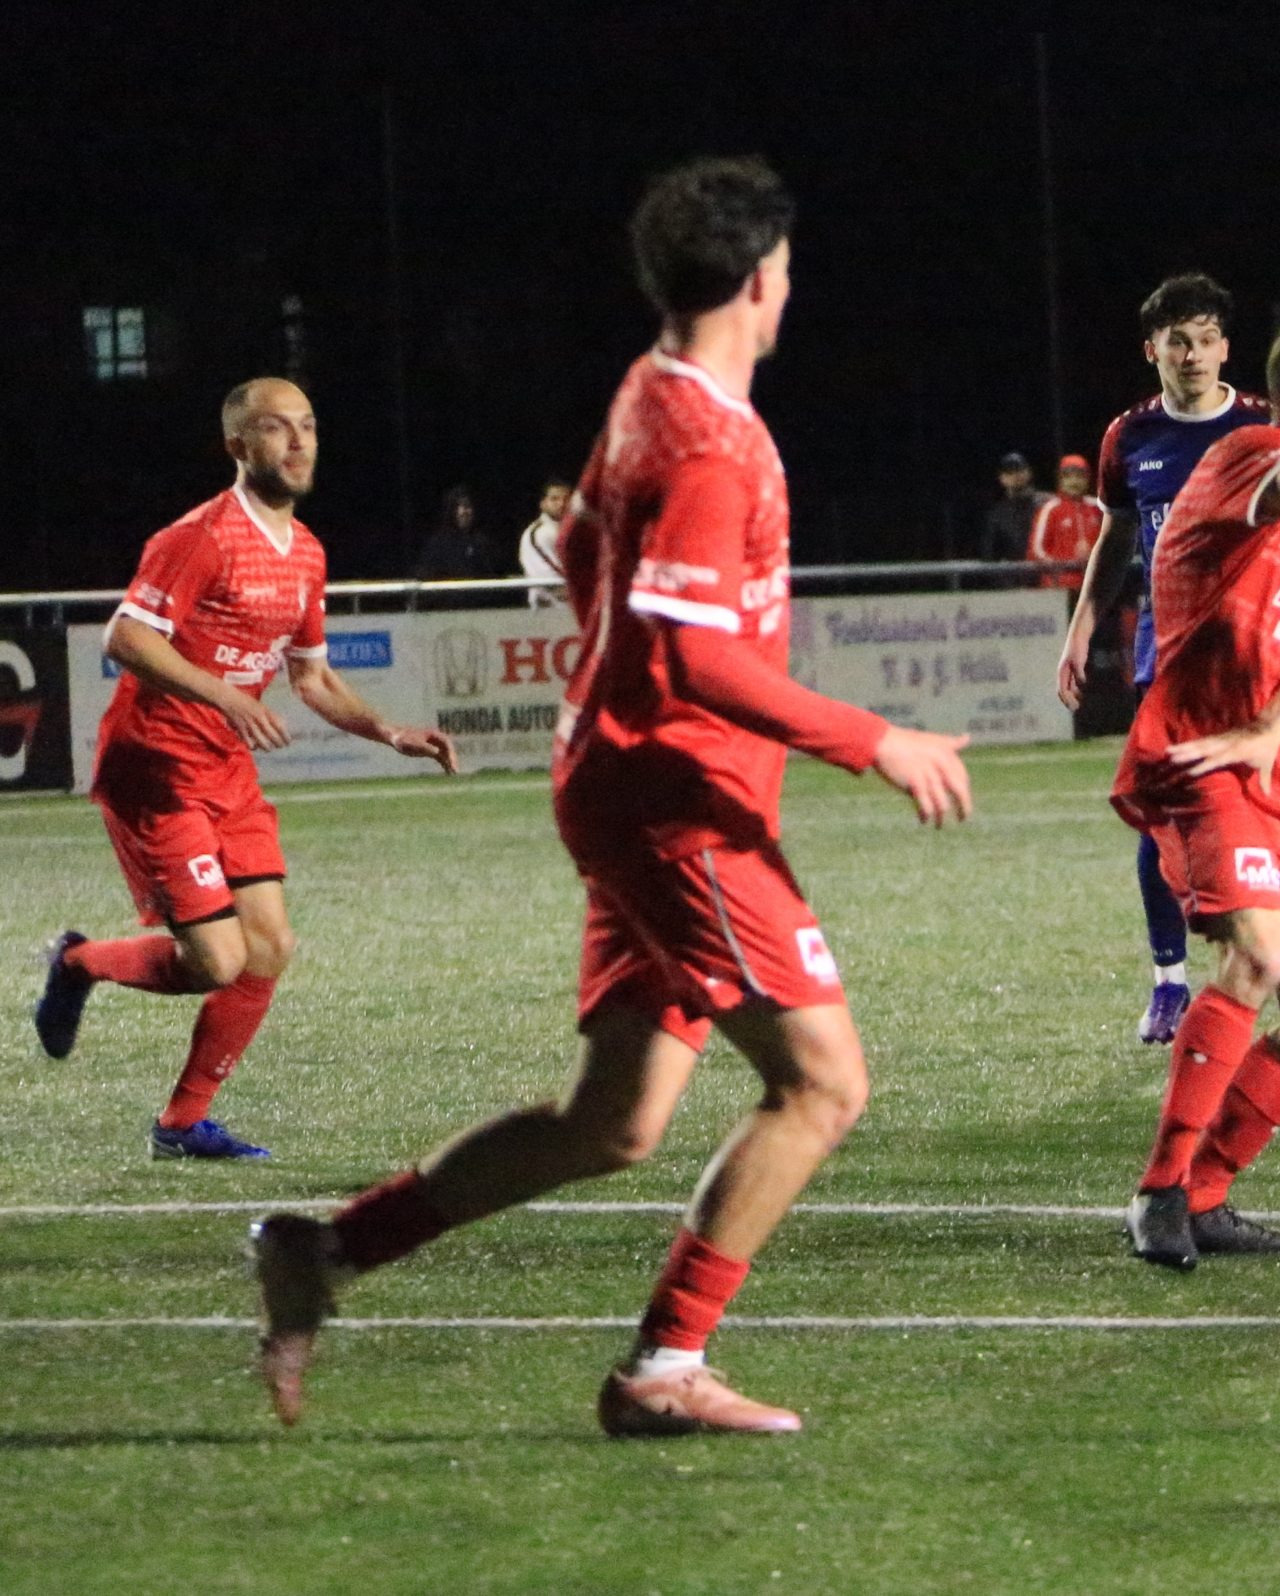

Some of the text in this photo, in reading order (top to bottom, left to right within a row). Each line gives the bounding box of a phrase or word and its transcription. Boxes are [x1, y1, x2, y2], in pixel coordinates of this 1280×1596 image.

[1139, 461, 1163, 471] JAKO
[214, 644, 240, 667] DE
[437, 705, 501, 735] HONDA
